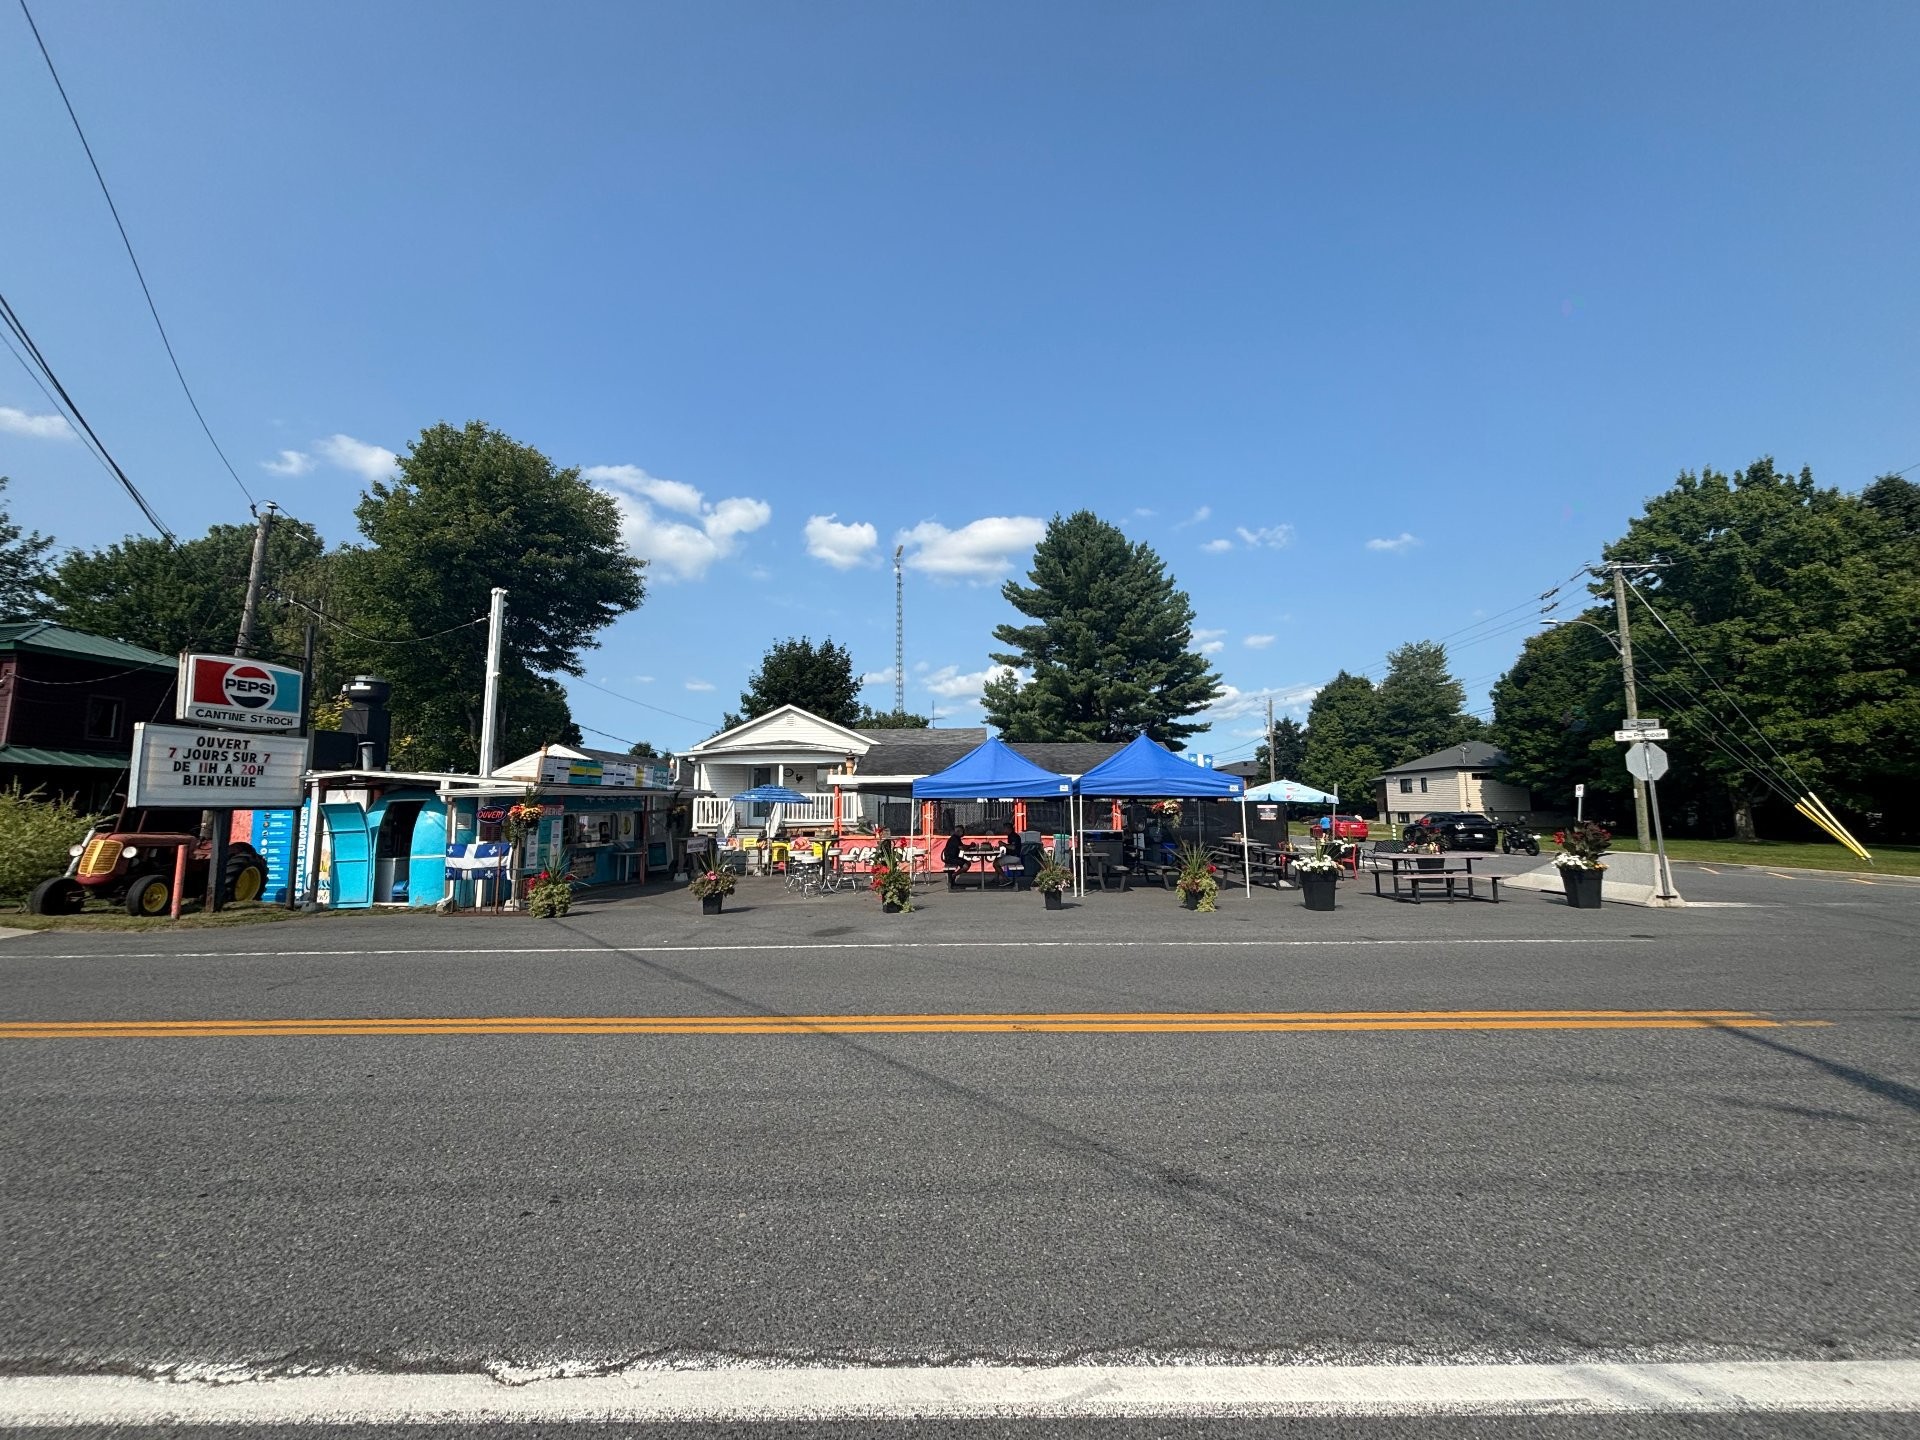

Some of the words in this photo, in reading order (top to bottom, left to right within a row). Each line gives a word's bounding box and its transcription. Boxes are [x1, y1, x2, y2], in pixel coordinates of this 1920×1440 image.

[225, 678, 275, 695] PEPSI
[196, 709, 246, 722] CANTINE
[250, 714, 293, 726] ST-ROCH
[197, 736, 251, 750] OUVERT
[169, 747, 177, 758] 7
[183, 748, 228, 761] JOURS
[233, 752, 257, 763] SUR
[263, 754, 271, 763] 7
[173, 761, 191, 772] DE
[224, 764, 233, 774] A
[241, 764, 264, 776] 20H
[183, 775, 256, 787] BIENVENUE
[478, 810, 504, 819] OUVERT
[297, 806, 309, 856] EUROPEEN
[294, 858, 305, 889] STYLE
